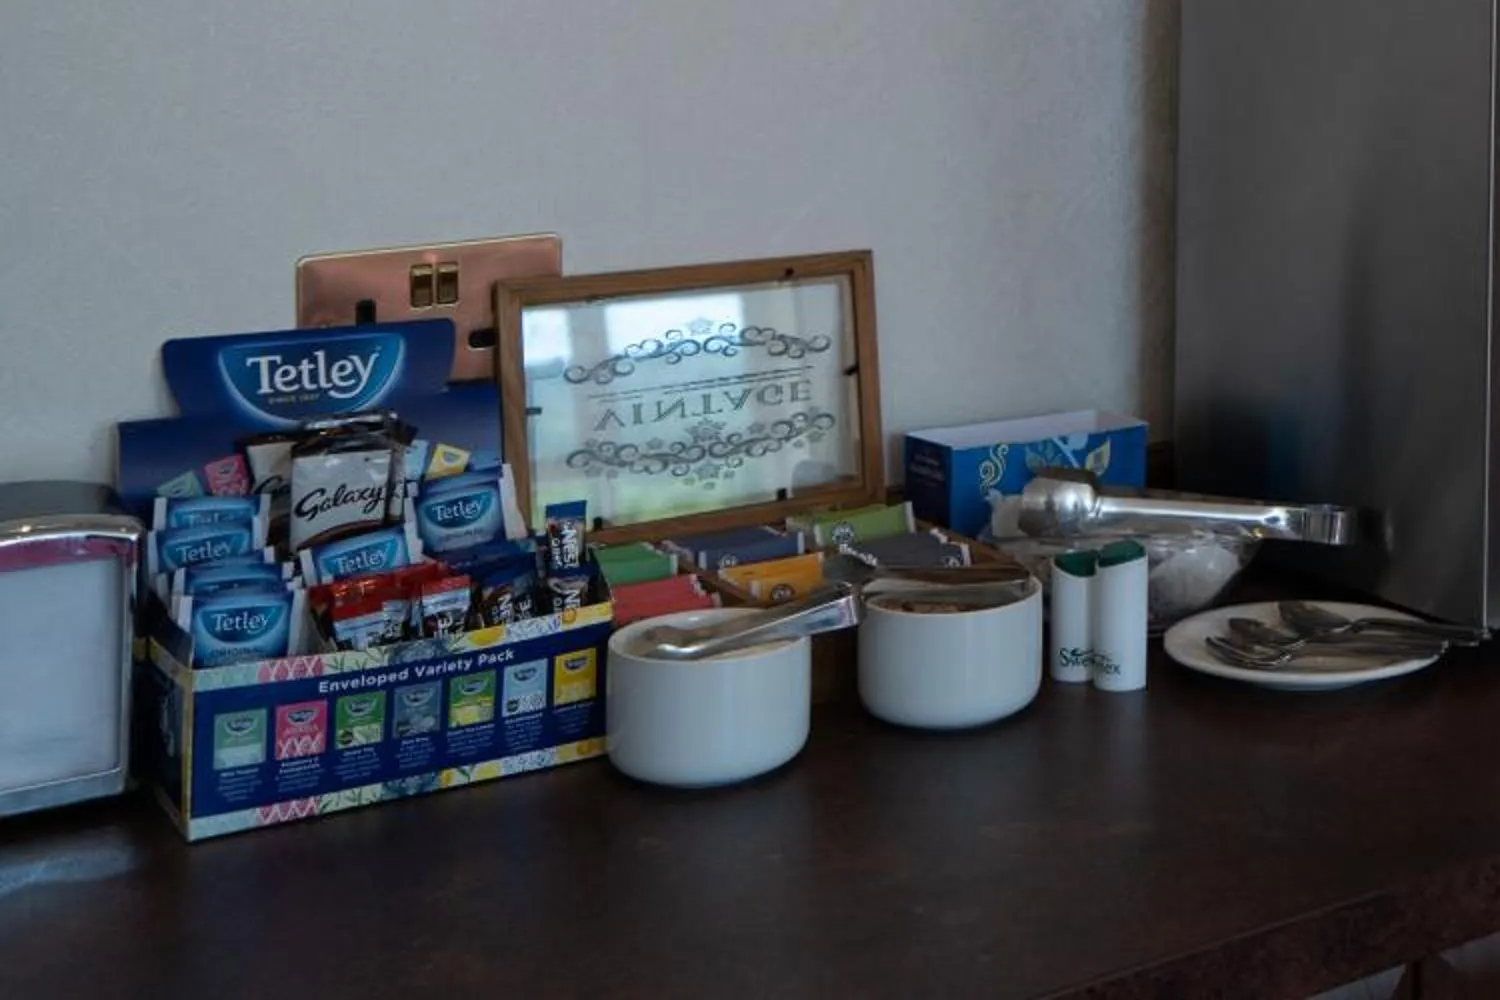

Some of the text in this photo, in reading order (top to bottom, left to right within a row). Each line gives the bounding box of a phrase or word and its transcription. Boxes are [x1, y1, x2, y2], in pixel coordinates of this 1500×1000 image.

[245, 349, 380, 399] Tetley
[293, 484, 389, 521] Galaxy
[431, 498, 485, 522] Tetley
[174, 541, 233, 565] Tetley
[331, 547, 391, 574] Tetley
[209, 612, 269, 636] Tetley
[319, 648, 515, 693] Enveloped Variety Pack
